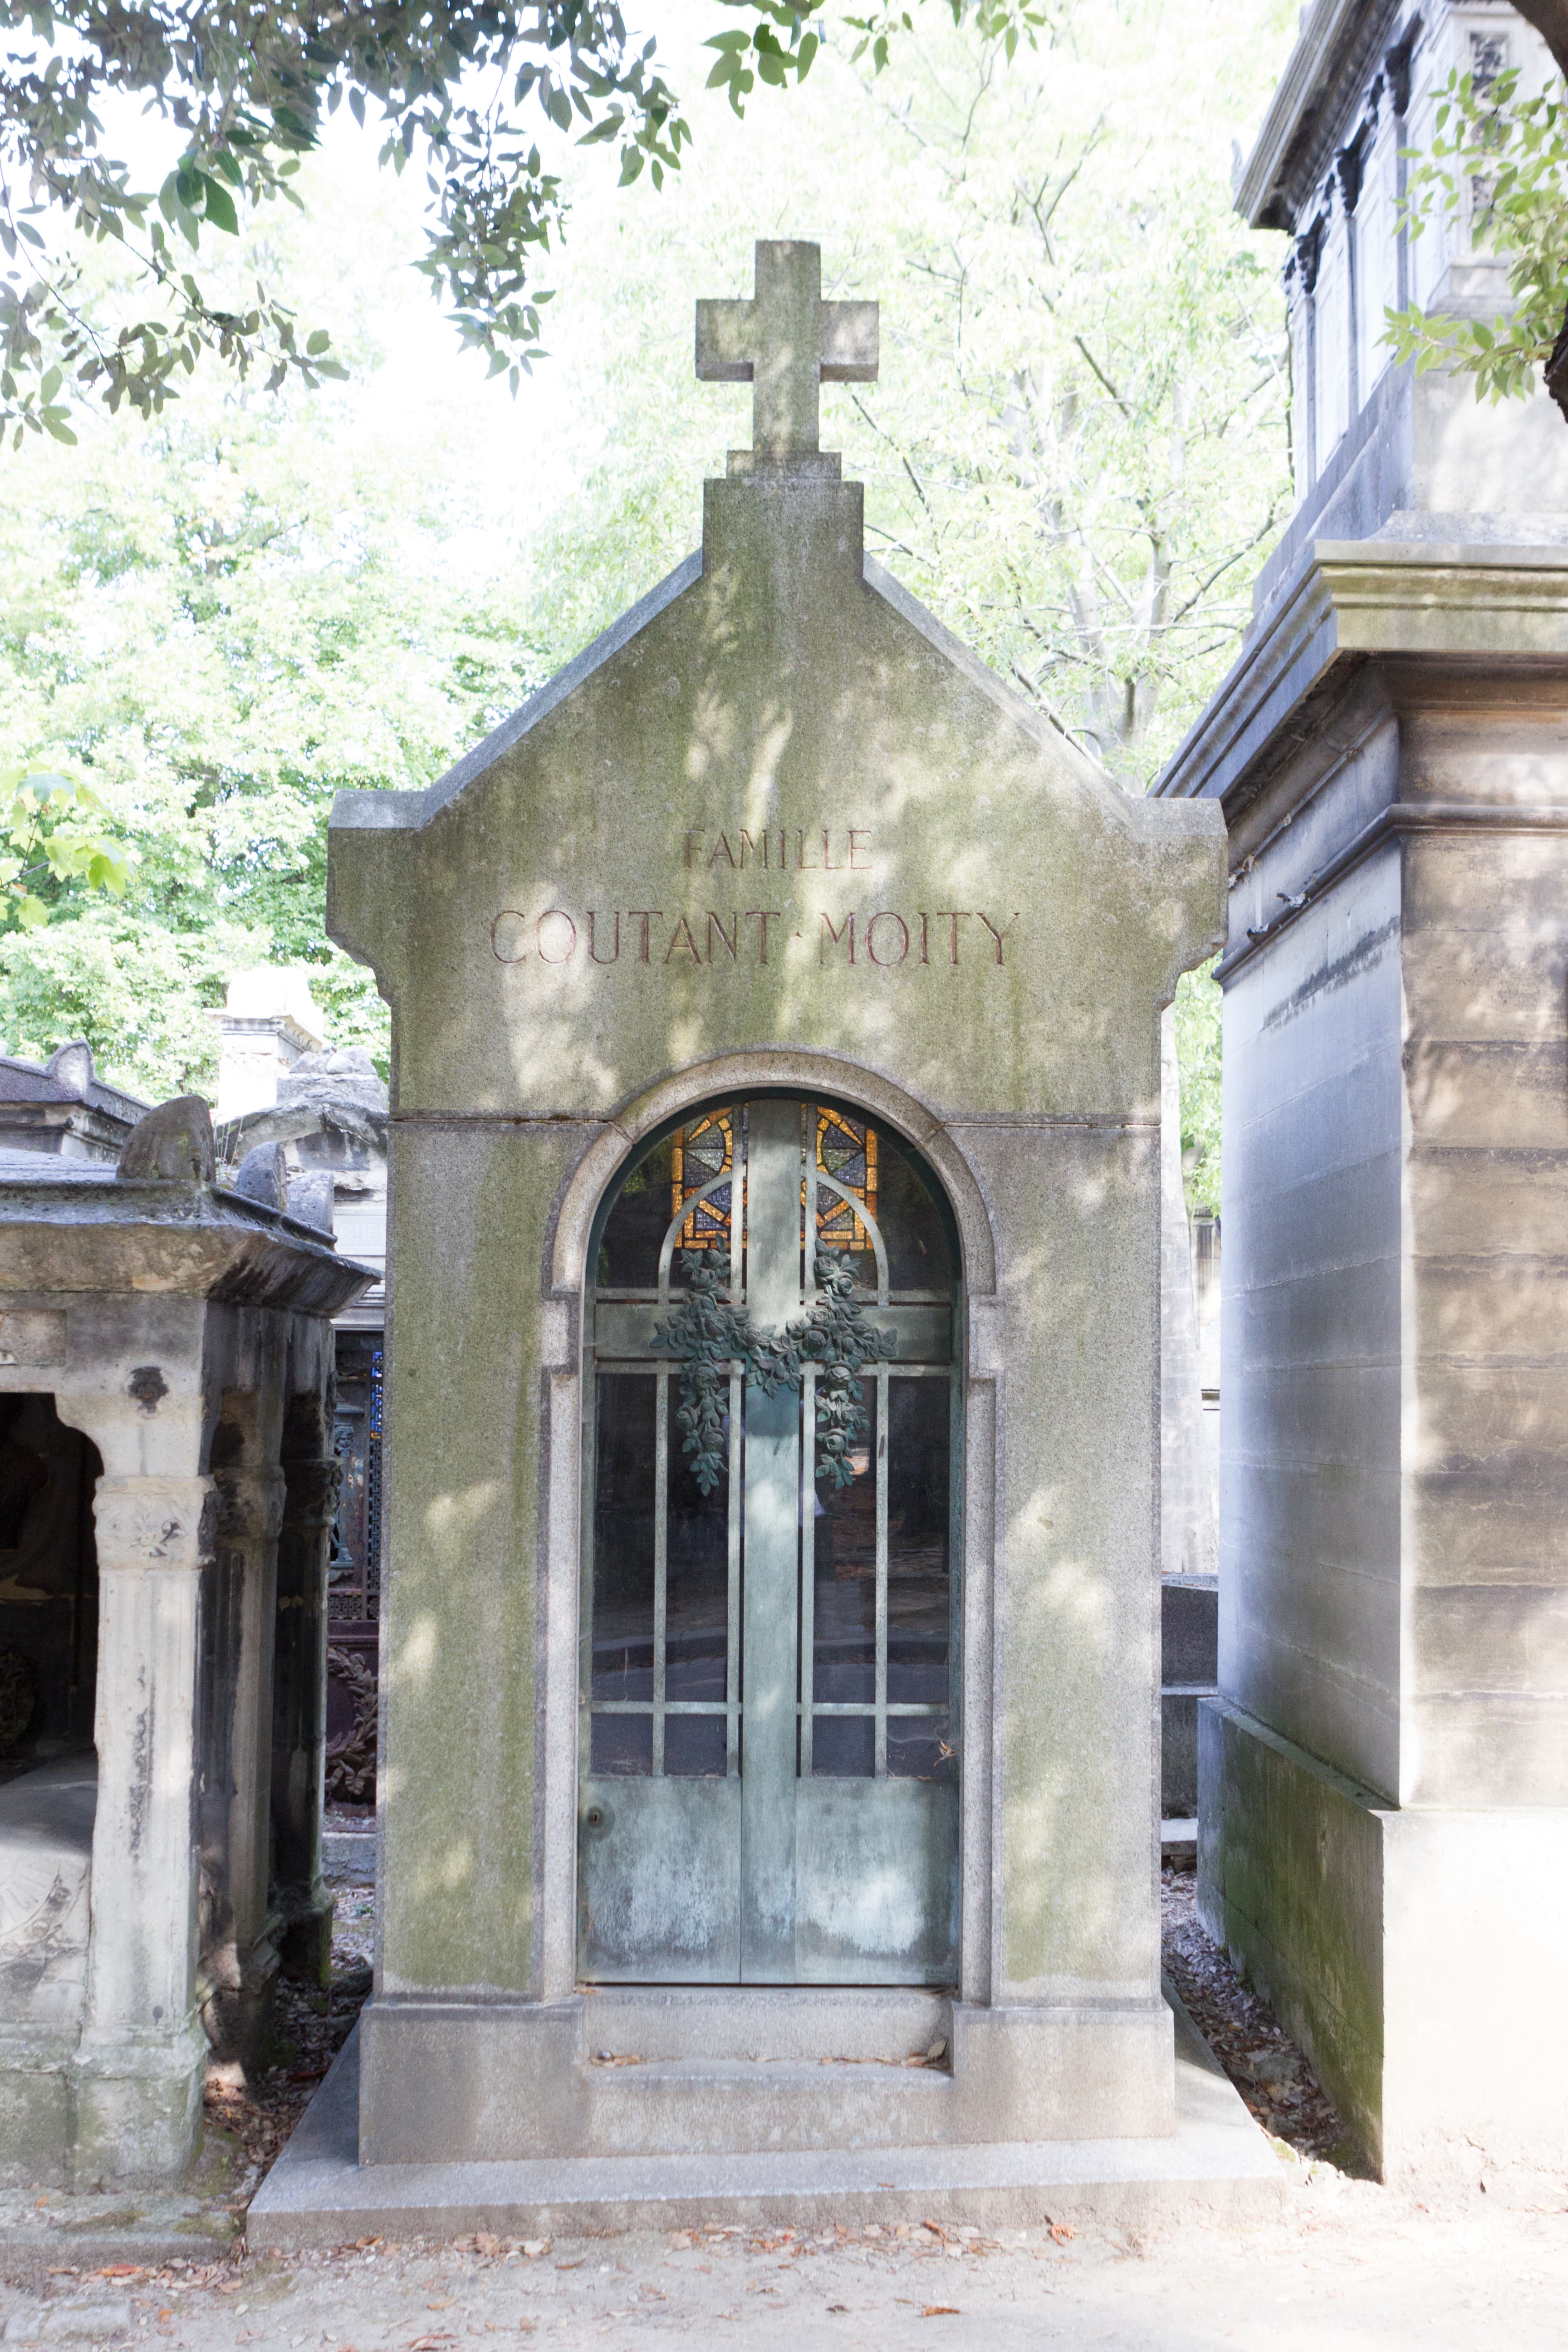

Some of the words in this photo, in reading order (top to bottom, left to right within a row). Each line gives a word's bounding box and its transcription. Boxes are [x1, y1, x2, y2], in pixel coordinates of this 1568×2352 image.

[686, 828, 873, 870] FAMILLE
[490, 910, 781, 965] COUTANT
[819, 911, 1022, 967] MOITY
